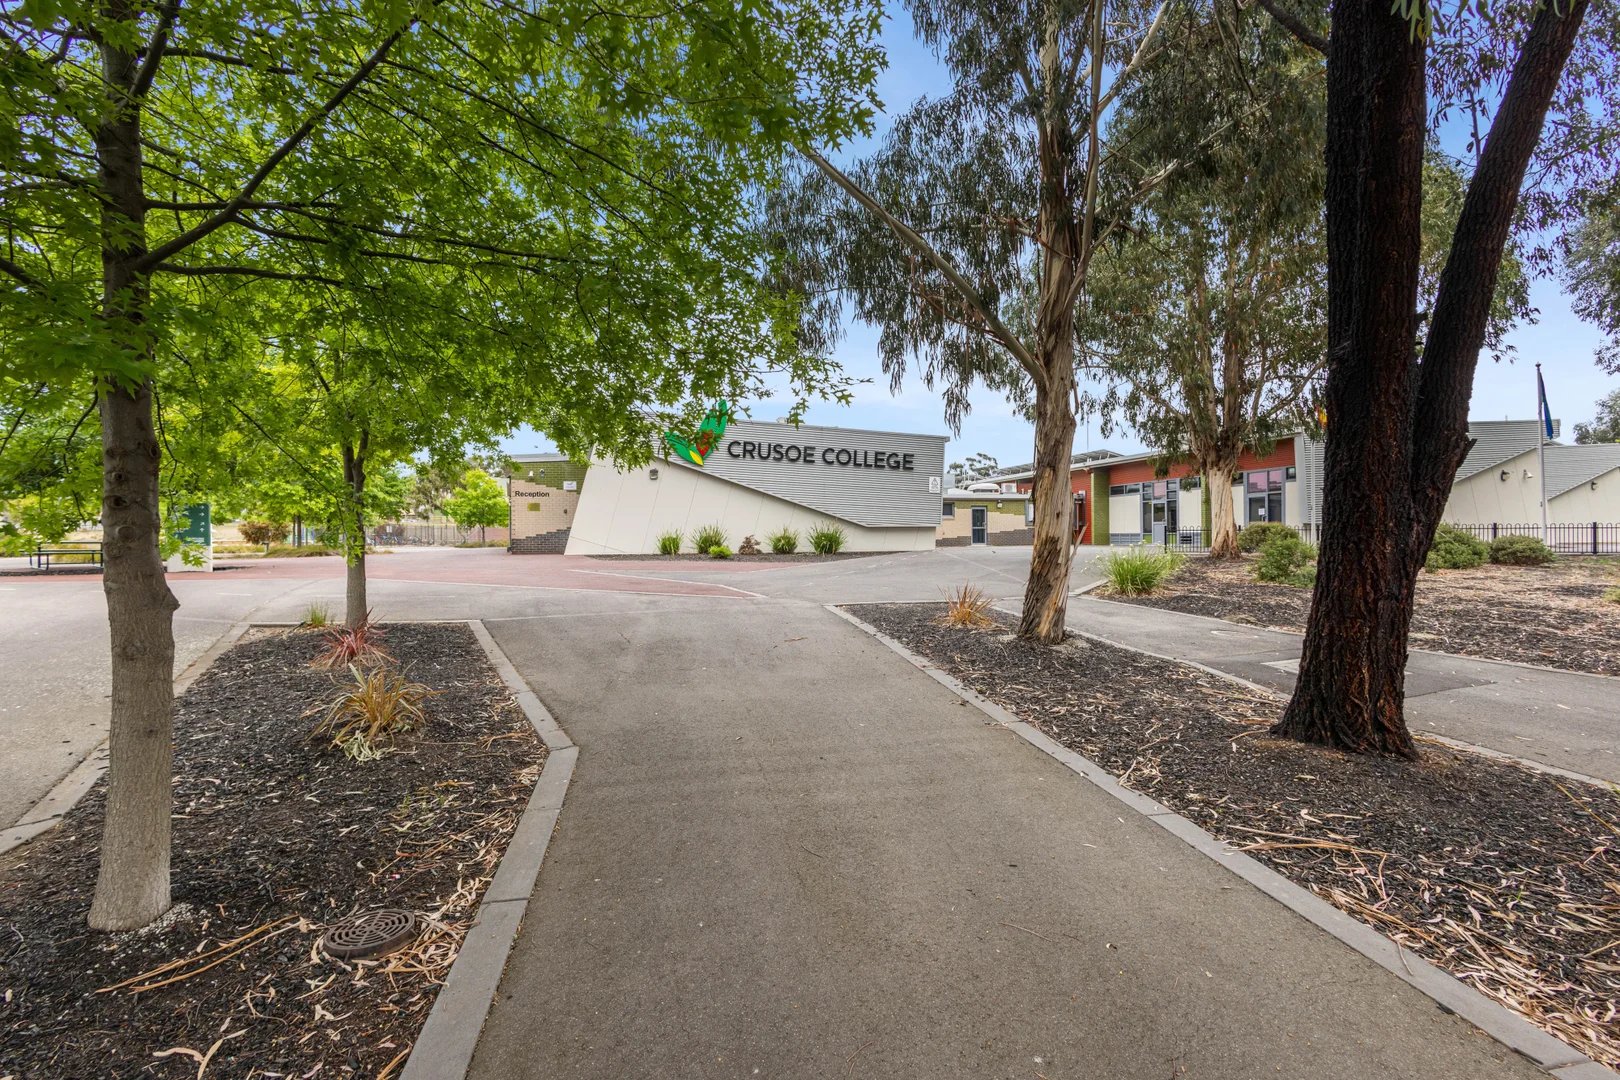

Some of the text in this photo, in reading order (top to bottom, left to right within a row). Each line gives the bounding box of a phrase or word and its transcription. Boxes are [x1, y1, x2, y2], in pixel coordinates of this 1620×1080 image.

[727, 440, 915, 471] CRUSOE COLLEGE
[514, 490, 550, 498] Reception
